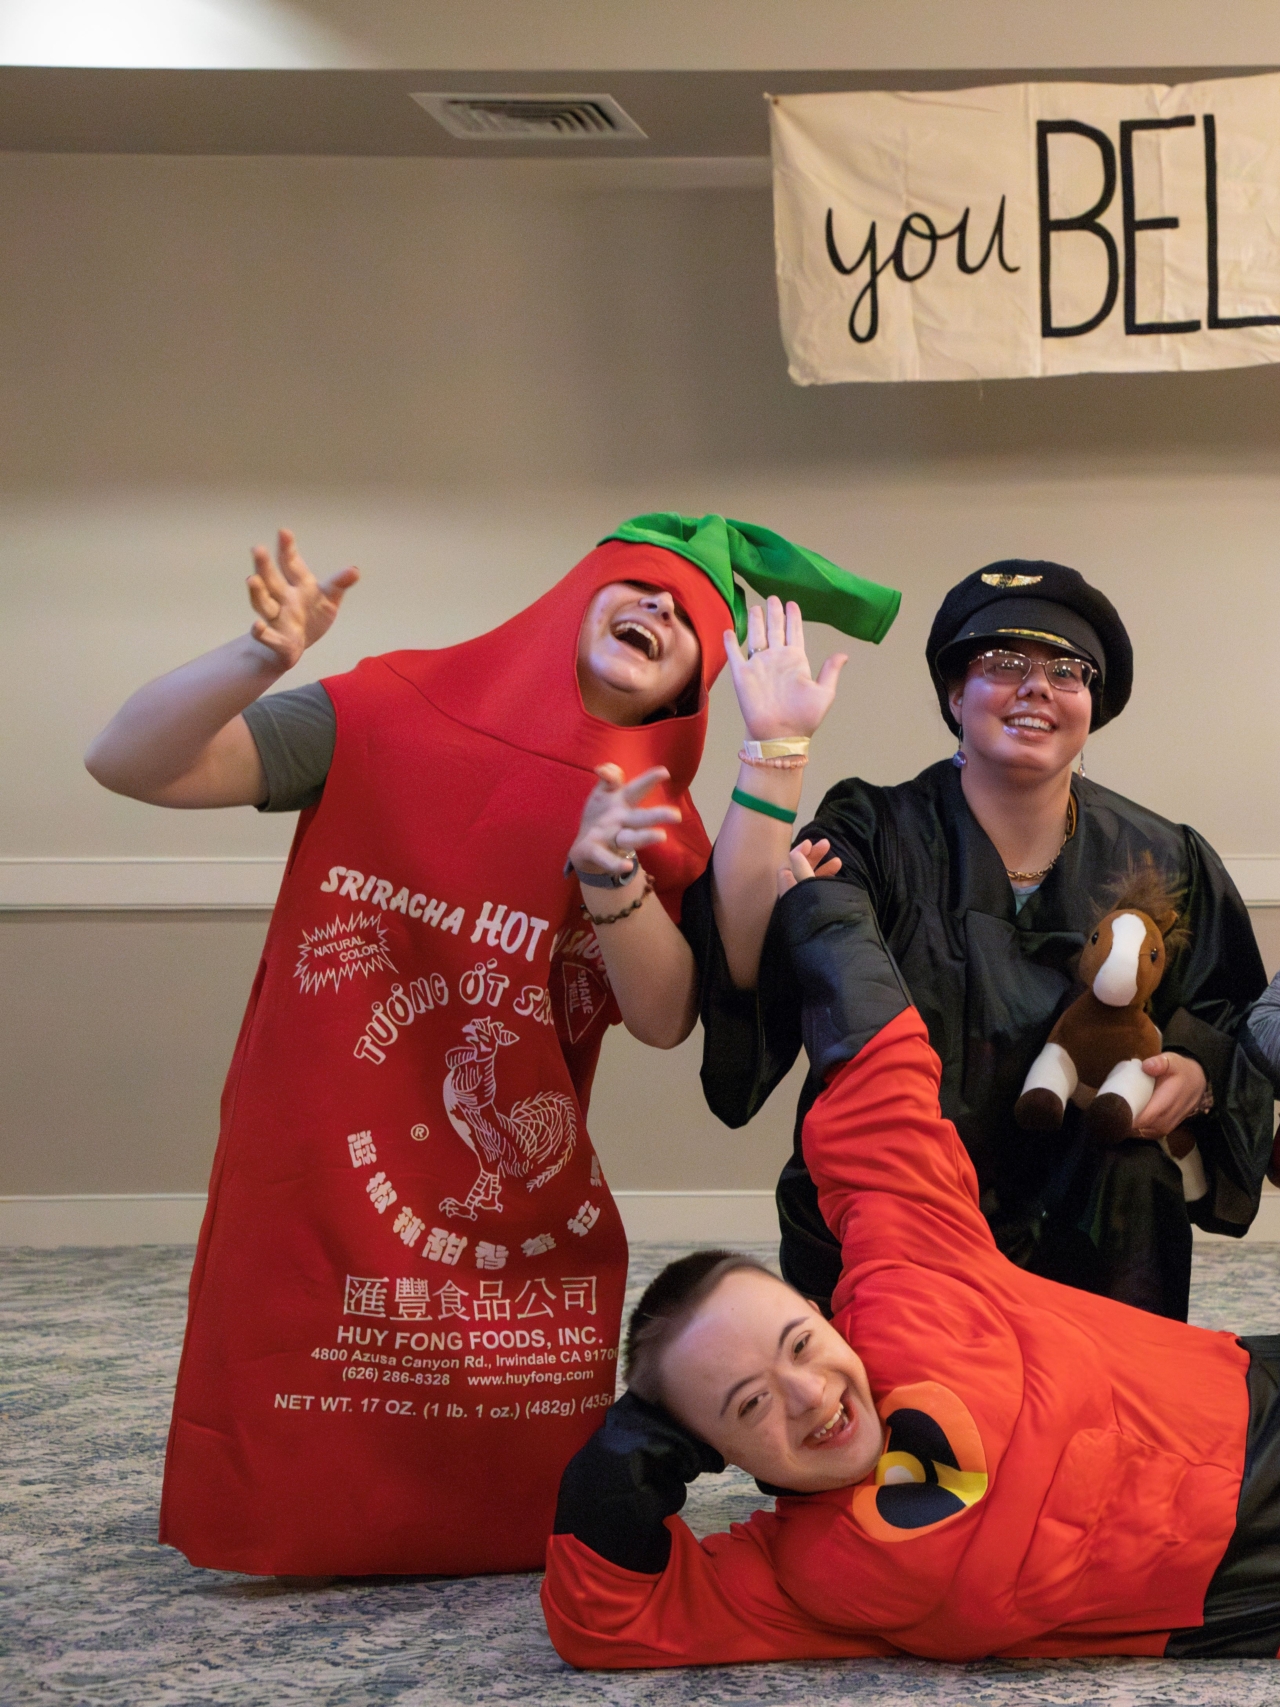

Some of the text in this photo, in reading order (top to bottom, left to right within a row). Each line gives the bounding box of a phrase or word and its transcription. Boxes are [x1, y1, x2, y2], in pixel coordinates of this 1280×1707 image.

[826, 194, 1020, 344] you
[320, 866, 465, 935] SRIRACHA
[470, 901, 549, 962] HOT
[314, 935, 366, 958] NATURAL
[339, 944, 379, 963] COLOR
[343, 1274, 597, 1321] 匯豐食品公司
[337, 1325, 603, 1351] HUY FONG FOODS, INC.
[311, 1347, 348, 1361] 4800
[351, 1350, 397, 1366] Azusa
[402, 1355, 460, 1371] Canyon
[464, 1355, 492, 1369] Rd.,
[496, 1352, 557, 1367] Irwindale
[560, 1350, 581, 1363] CA
[342, 1366, 594, 1387] (626) 286-8328 www.huyfong.com
[274, 1393, 315, 1411] NET
[320, 1396, 353, 1412] WT.
[361, 1398, 381, 1413] 17
[385, 1400, 417, 1416] OZ.
[423, 1402, 440, 1419] (1
[446, 1403, 468, 1418] lb.
[475, 1403, 484, 1418] 1
[490, 1403, 520, 1420] oz.)
[526, 1399, 577, 1419] (482g)
